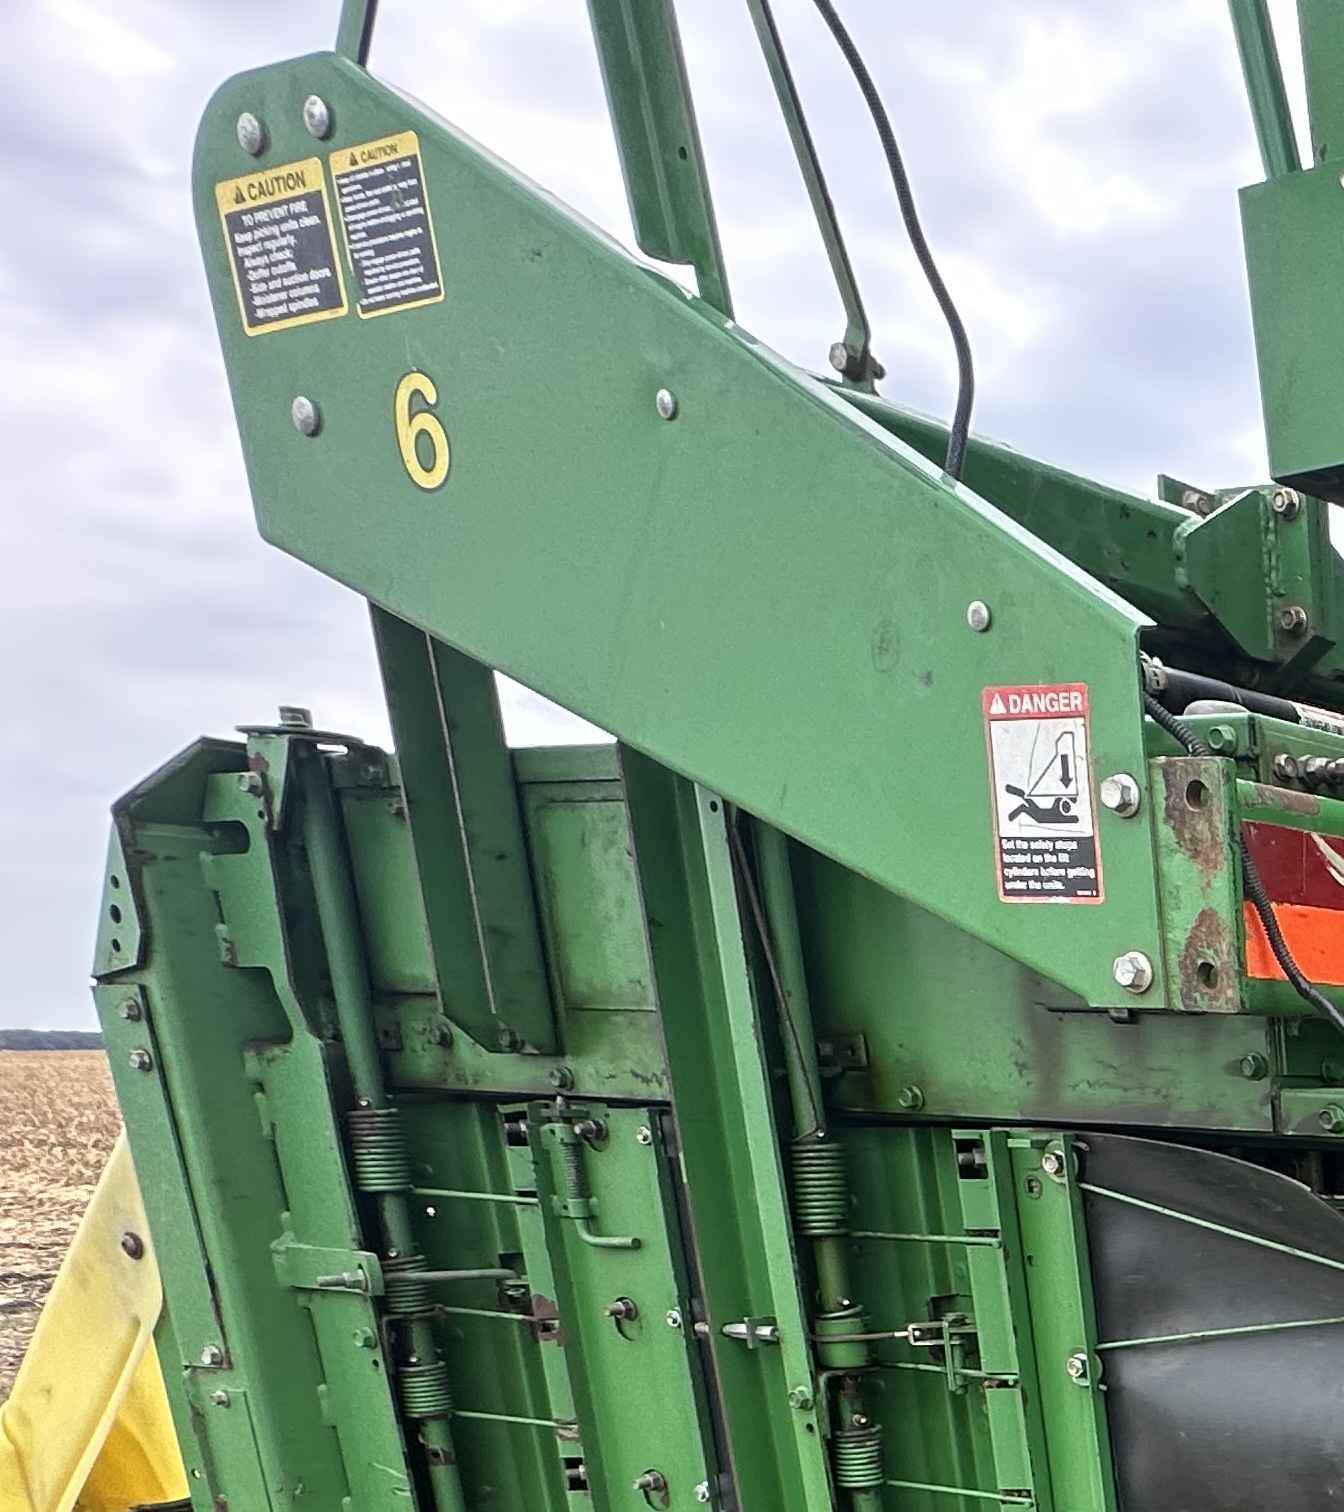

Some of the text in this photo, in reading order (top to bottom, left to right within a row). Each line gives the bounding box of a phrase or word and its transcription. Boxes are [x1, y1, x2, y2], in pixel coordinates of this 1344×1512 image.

[360, 142, 399, 164] CAUTION
[247, 171, 306, 200] CAUTION
[394, 370, 450, 490] 6
[1009, 691, 1083, 714] DANGER
[1016, 839, 1028, 849] the
[1030, 839, 1053, 851] safety
[1003, 853, 1031, 864] located
[1044, 853, 1057, 863] the
[1004, 867, 1039, 879] cylinders
[1041, 867, 1066, 877] before
[1029, 880, 1041, 889] the
